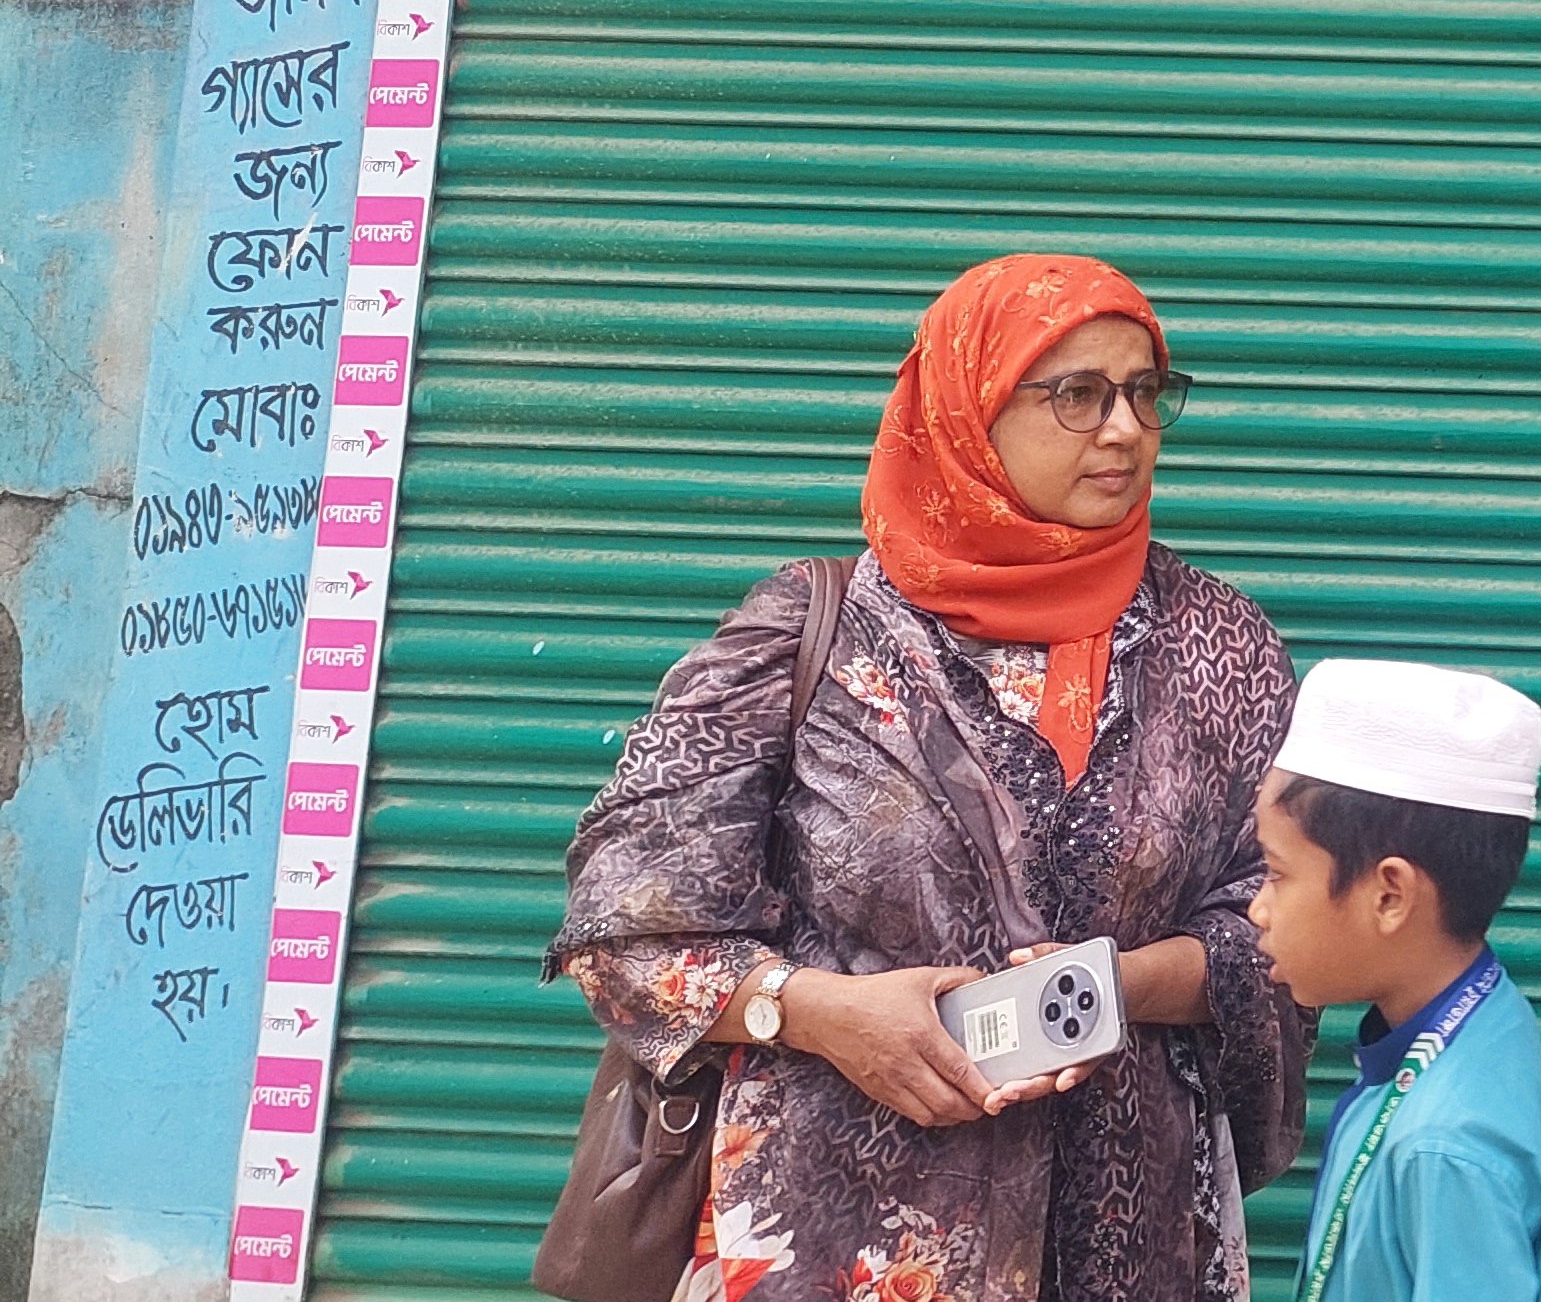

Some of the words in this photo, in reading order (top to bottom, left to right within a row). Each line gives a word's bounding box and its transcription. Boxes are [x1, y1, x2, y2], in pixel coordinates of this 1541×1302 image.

[202, 41, 350, 134] গ্যাসের
[370, 84, 429, 105] পেমেন্ট
[233, 140, 343, 220] জন্য
[355, 221, 413, 243] পেমেন্ট
[208, 223, 345, 292] ফোন
[208, 297, 340, 354] করুন
[339, 361, 398, 383] পেমেন্ট
[193, 383, 320, 452] মোবাঃ
[134, 476, 323, 561] ০১৯৪৩-৯৫৯৩৮
[323, 502, 383, 524] পেমেন্ট
[306, 645, 366, 667] পেমেন্ট
[156, 686, 270, 760] হোম
[97, 751, 266, 873] ডেলিভারি
[289, 789, 348, 812] পেমেন্ট
[126, 873, 248, 948] দেওয়া
[271, 936, 330, 959] পেমেন্ট
[253, 1085, 312, 1108] পেমেন্ট
[235, 1235, 293, 1258] পেমেন্ট
